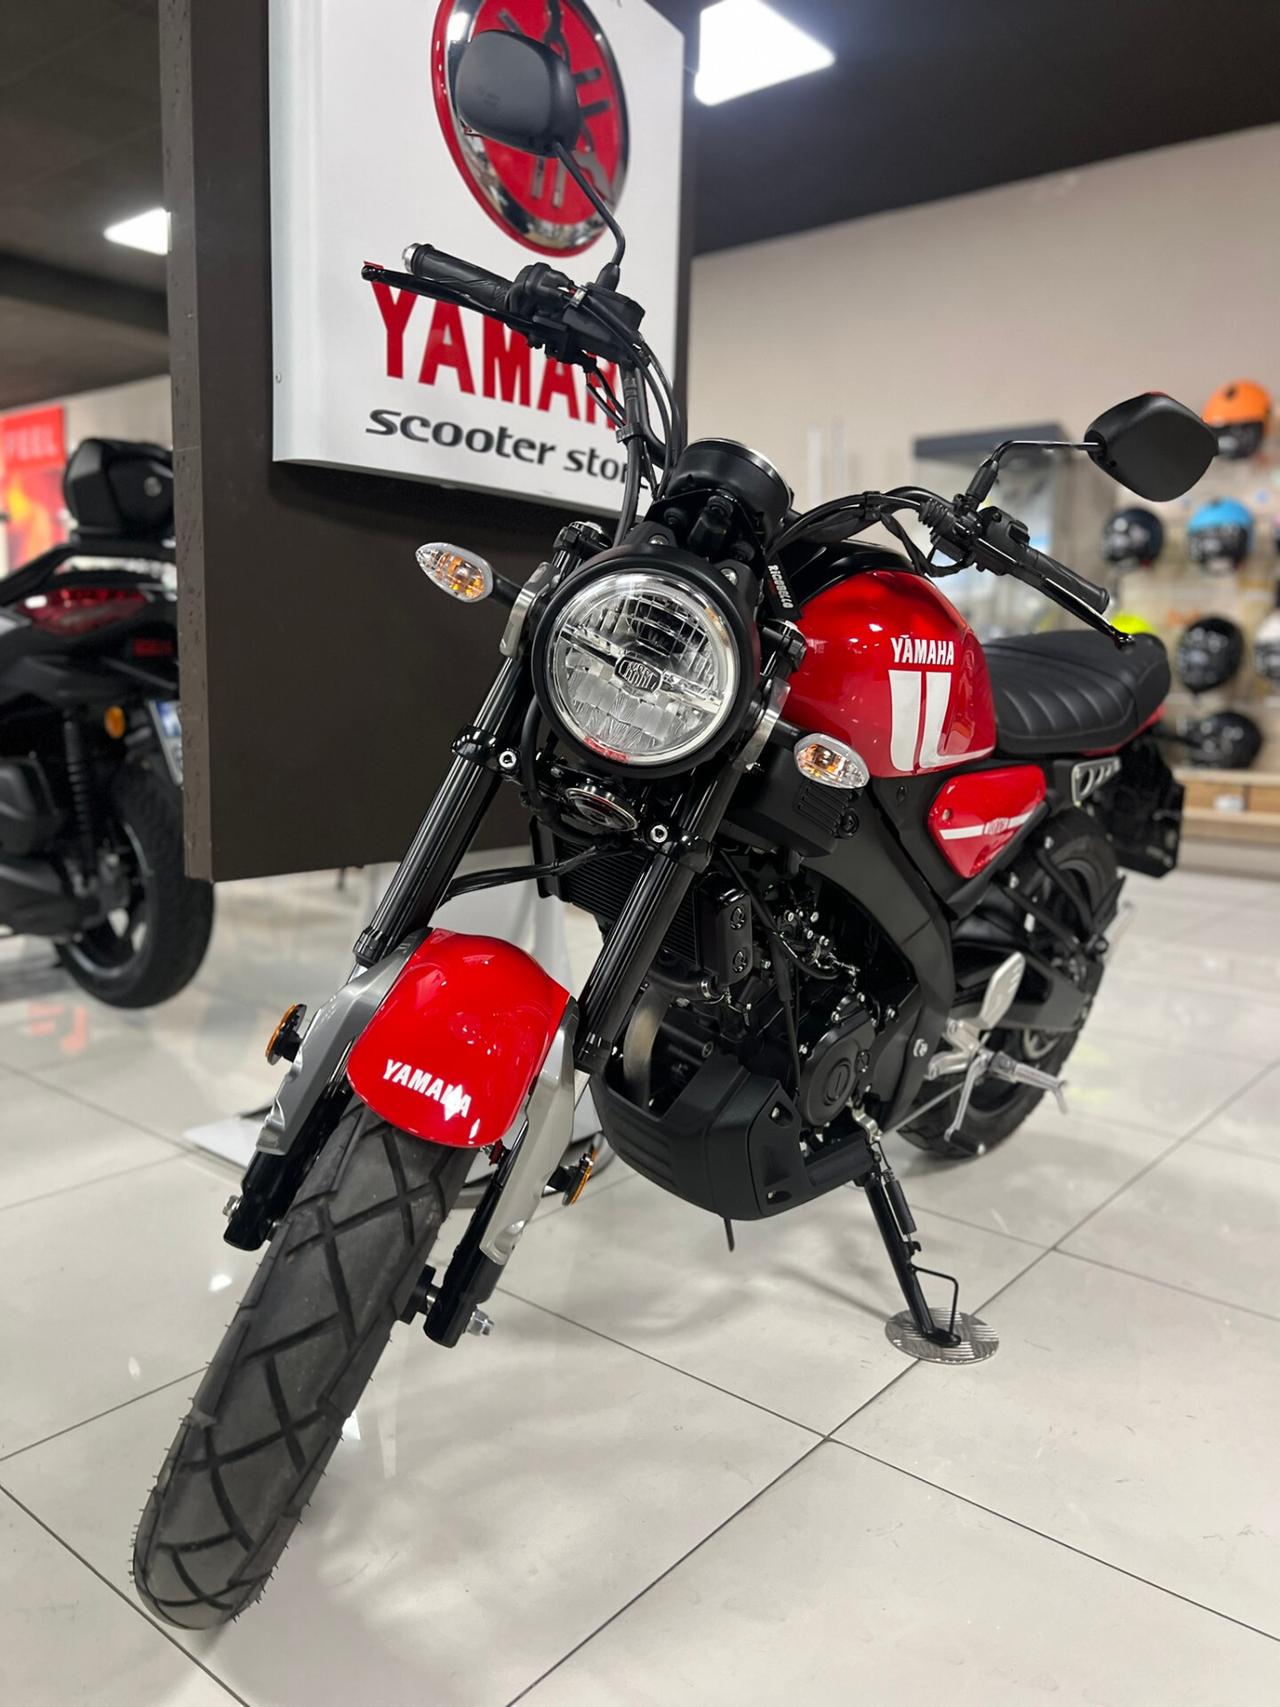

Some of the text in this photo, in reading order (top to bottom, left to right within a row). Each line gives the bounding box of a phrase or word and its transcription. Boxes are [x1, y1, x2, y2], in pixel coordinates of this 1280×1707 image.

[363, 261, 618, 431] YAMAH
[365, 409, 649, 490] scooter stor
[890, 637, 955, 666] YAMAHA
